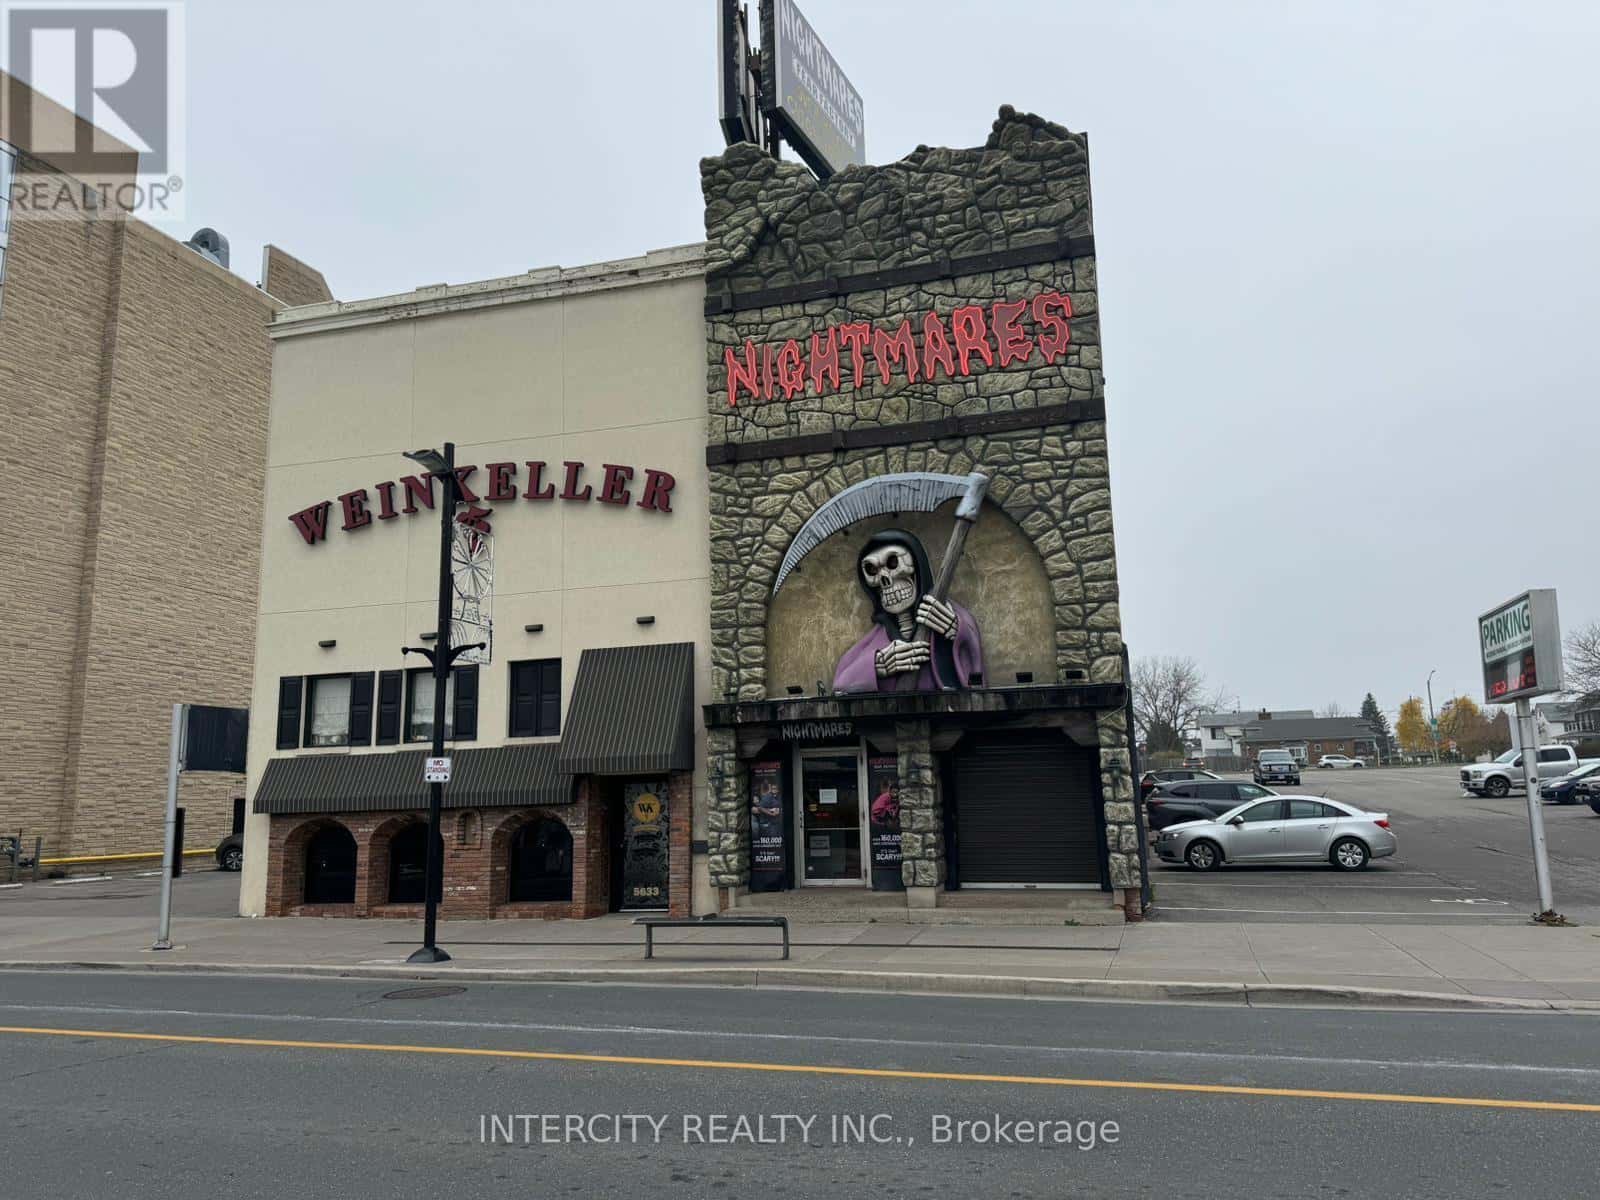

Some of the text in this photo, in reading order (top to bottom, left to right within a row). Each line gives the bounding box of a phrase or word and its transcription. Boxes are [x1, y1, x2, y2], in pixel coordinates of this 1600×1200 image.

[781, 0, 862, 136] NIGHTMARES
[724, 292, 1072, 407] NIGHTMARES
[288, 460, 676, 545] WEINKELLER
[1483, 603, 1530, 647] PARKING
[782, 721, 852, 740] NIGHTMARES
